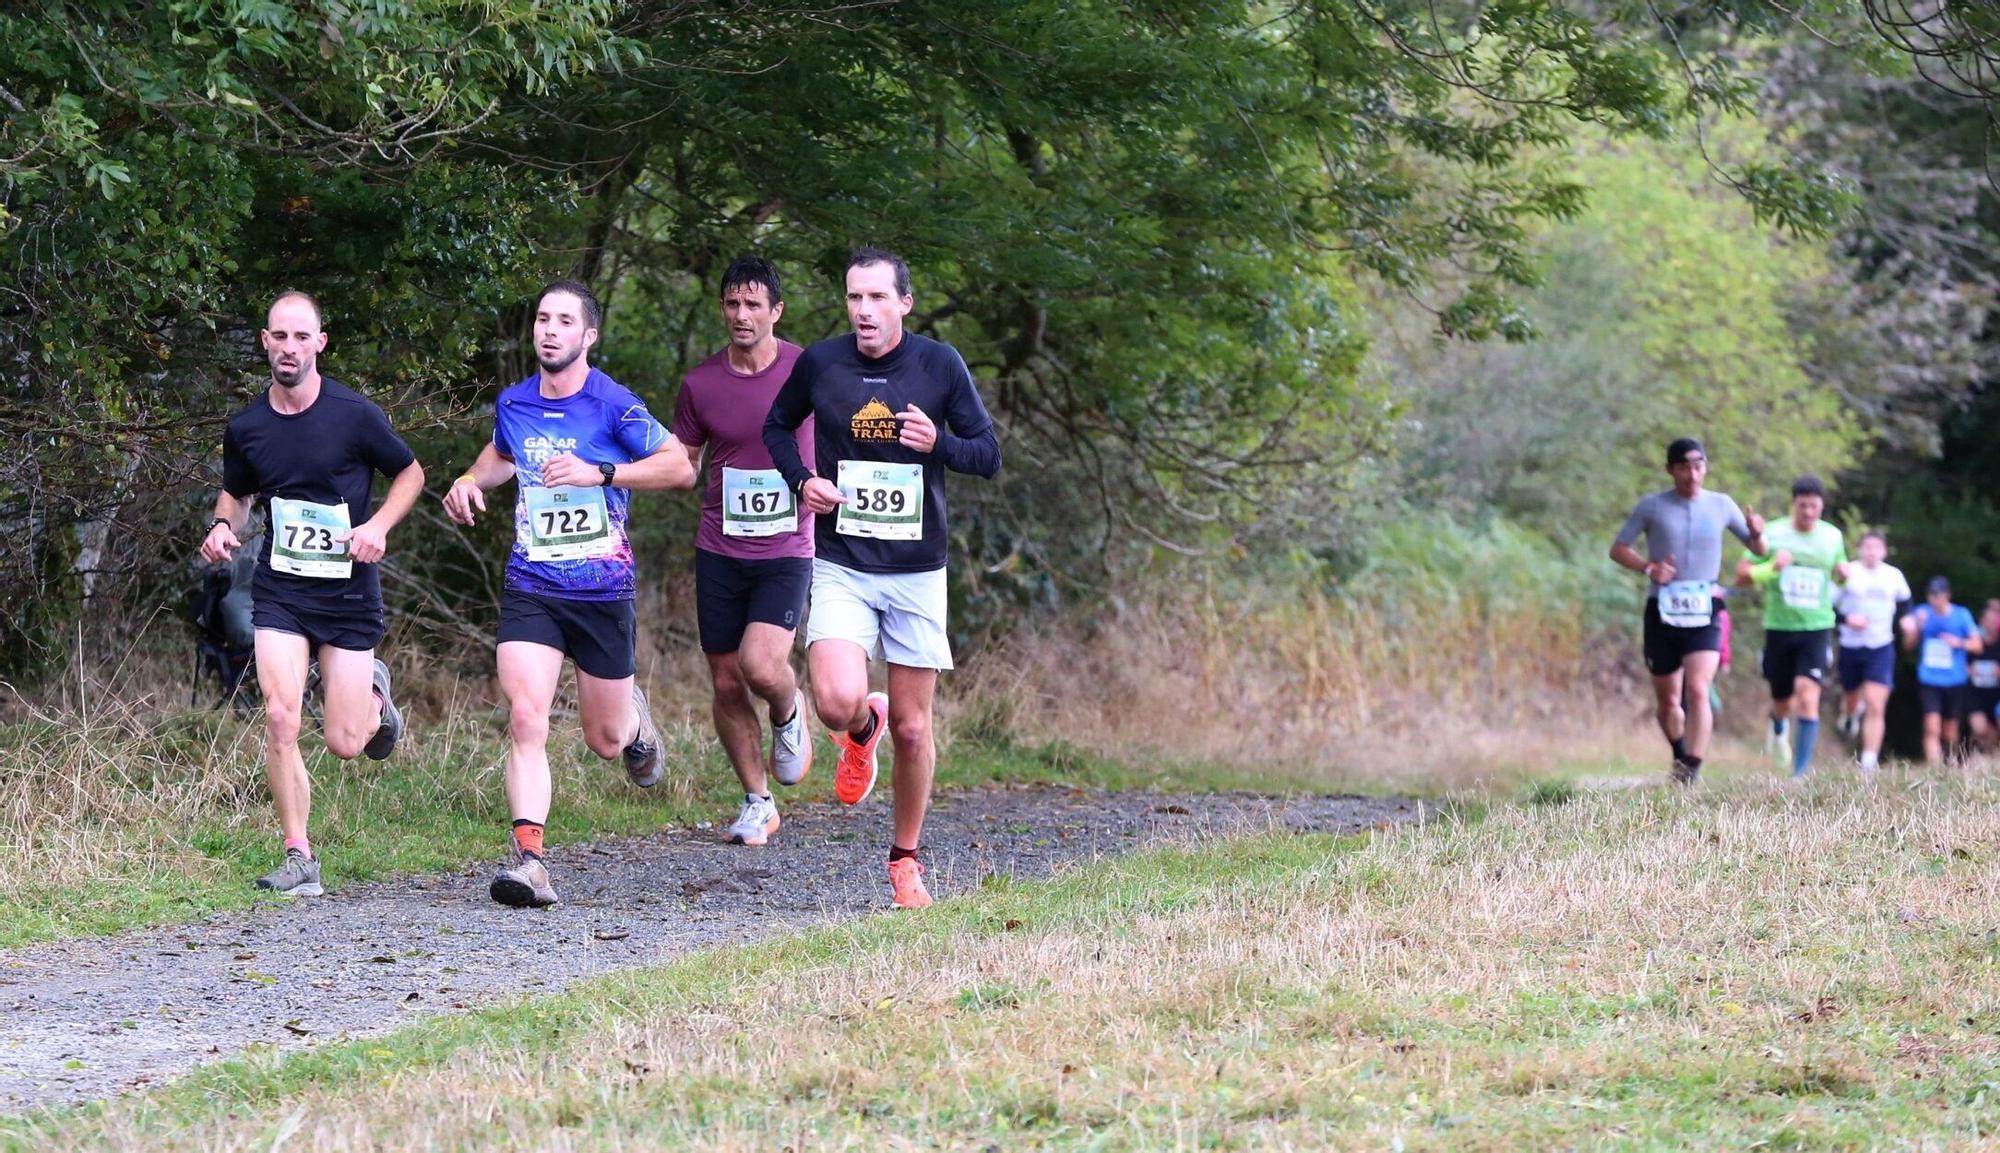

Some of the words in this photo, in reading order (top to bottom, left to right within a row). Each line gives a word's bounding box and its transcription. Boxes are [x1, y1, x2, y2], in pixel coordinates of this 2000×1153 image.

[851, 420, 896, 429] GALAR
[851, 428, 897, 439] TRAIL
[738, 491, 780, 513] 167
[856, 488, 905, 513] 589
[540, 509, 591, 535] 722
[285, 525, 333, 551] 723
